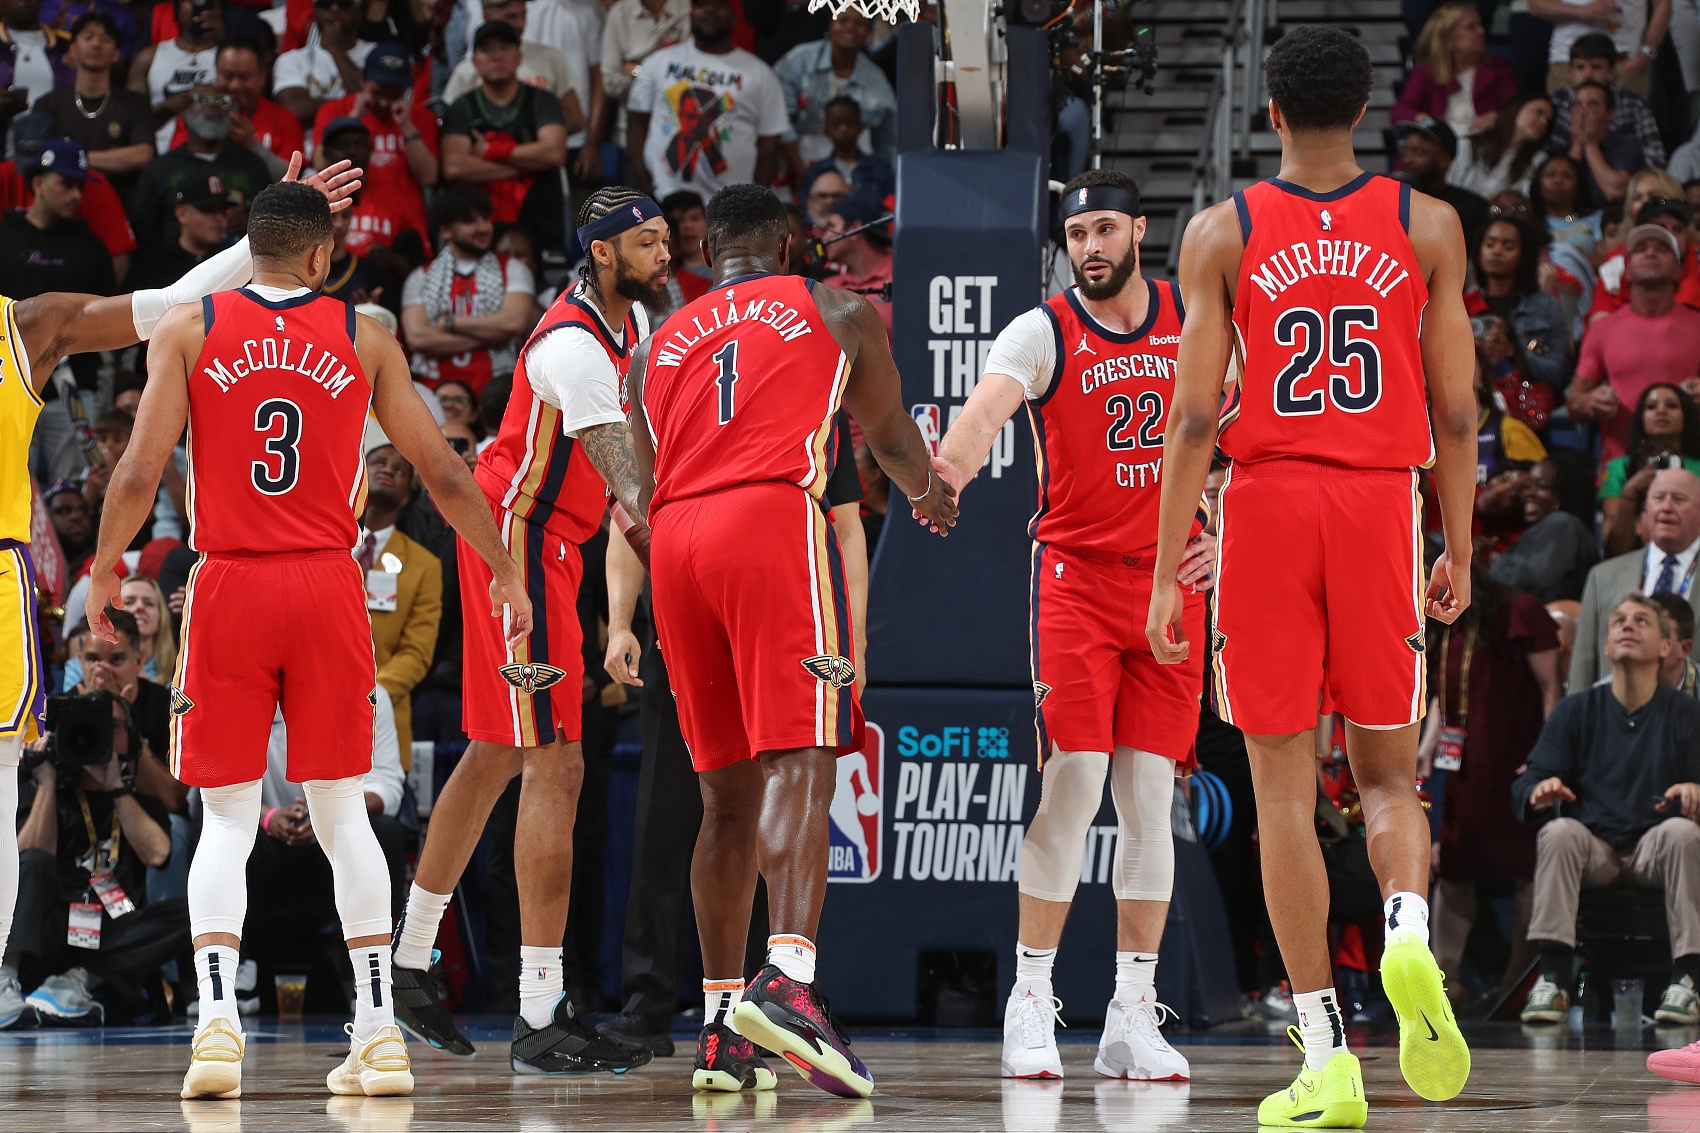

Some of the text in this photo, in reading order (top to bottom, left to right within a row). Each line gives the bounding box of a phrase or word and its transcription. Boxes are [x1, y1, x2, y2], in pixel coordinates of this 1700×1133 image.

[1249, 239, 1409, 302] MURPHY III
[655, 299, 813, 368] WILLIAMSON
[928, 274, 998, 334] GET
[203, 337, 356, 400] McCOLLUM
[1149, 334, 1181, 346] ibotta
[1273, 305, 1382, 417] 25
[712, 339, 739, 426] 1
[1081, 353, 1178, 395] CRESCENT
[251, 397, 303, 496] 3
[1105, 390, 1165, 451] 22
[1115, 457, 1163, 488] CITY
[897, 725, 971, 757] SoFi
[894, 762, 1028, 821] PLAY-IN
[892, 822, 1118, 884] TOURNANT
